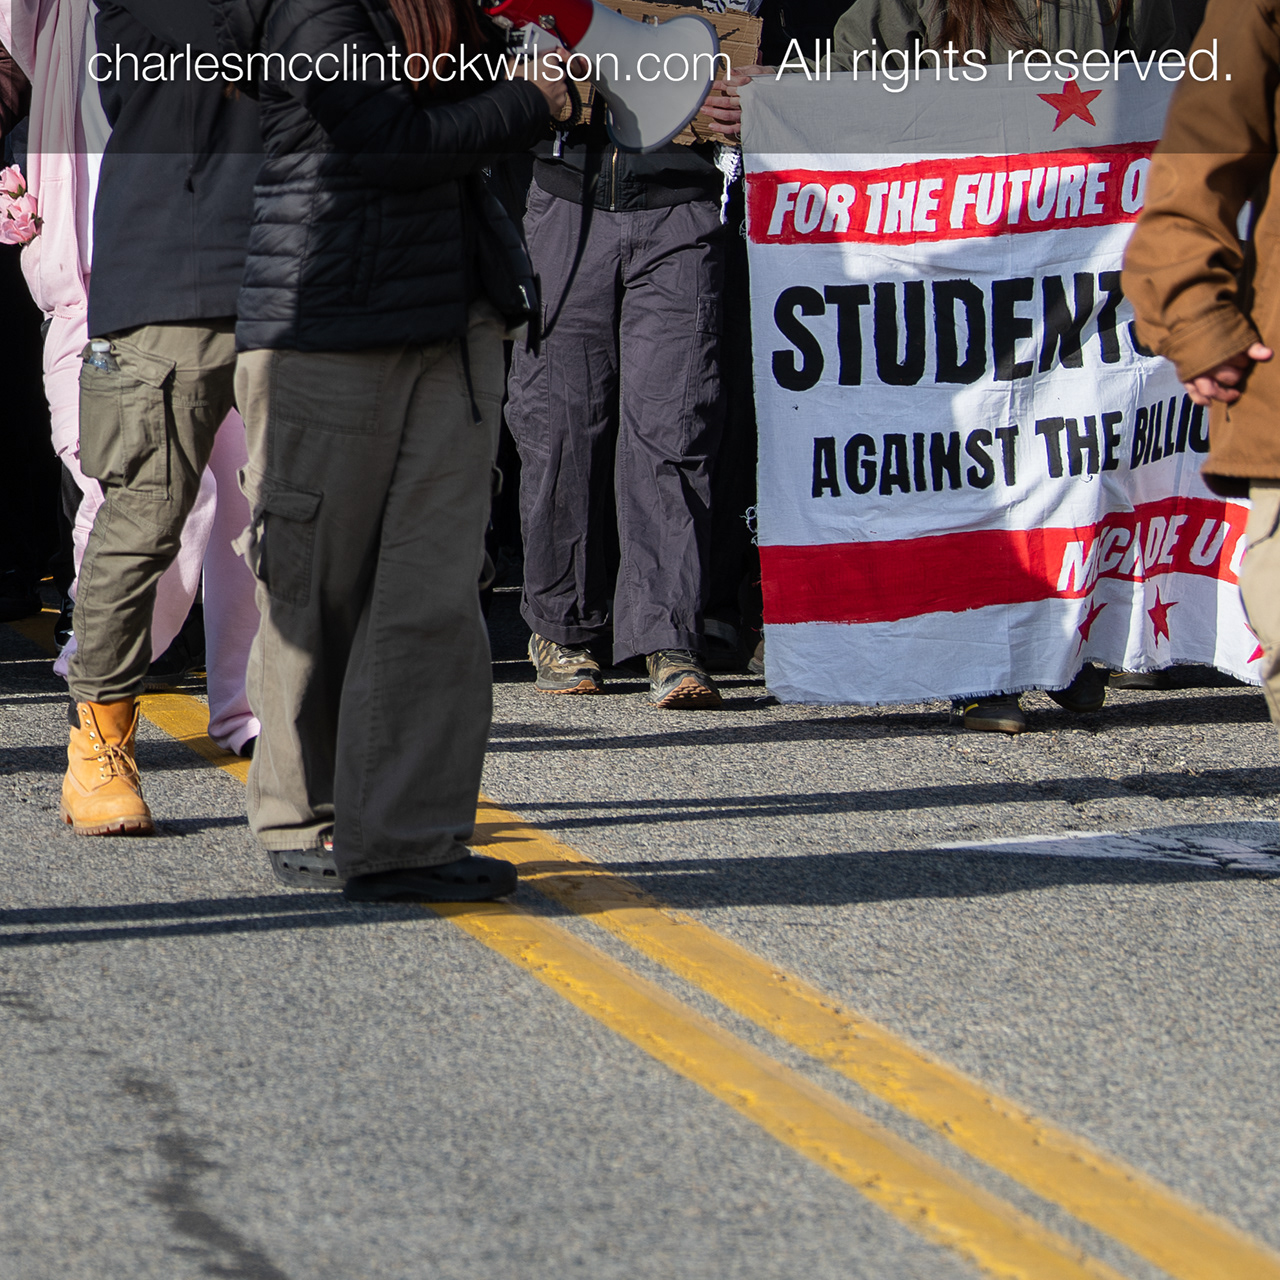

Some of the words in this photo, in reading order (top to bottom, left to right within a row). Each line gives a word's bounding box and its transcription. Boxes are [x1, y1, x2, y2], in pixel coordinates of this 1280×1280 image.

[767, 181, 856, 236] FOR
[863, 177, 943, 235] THE
[947, 161, 1110, 229] FUTURE
[771, 271, 1163, 391] STUDENT
[811, 425, 1018, 498] AGAINST
[1035, 411, 1122, 477] THE
